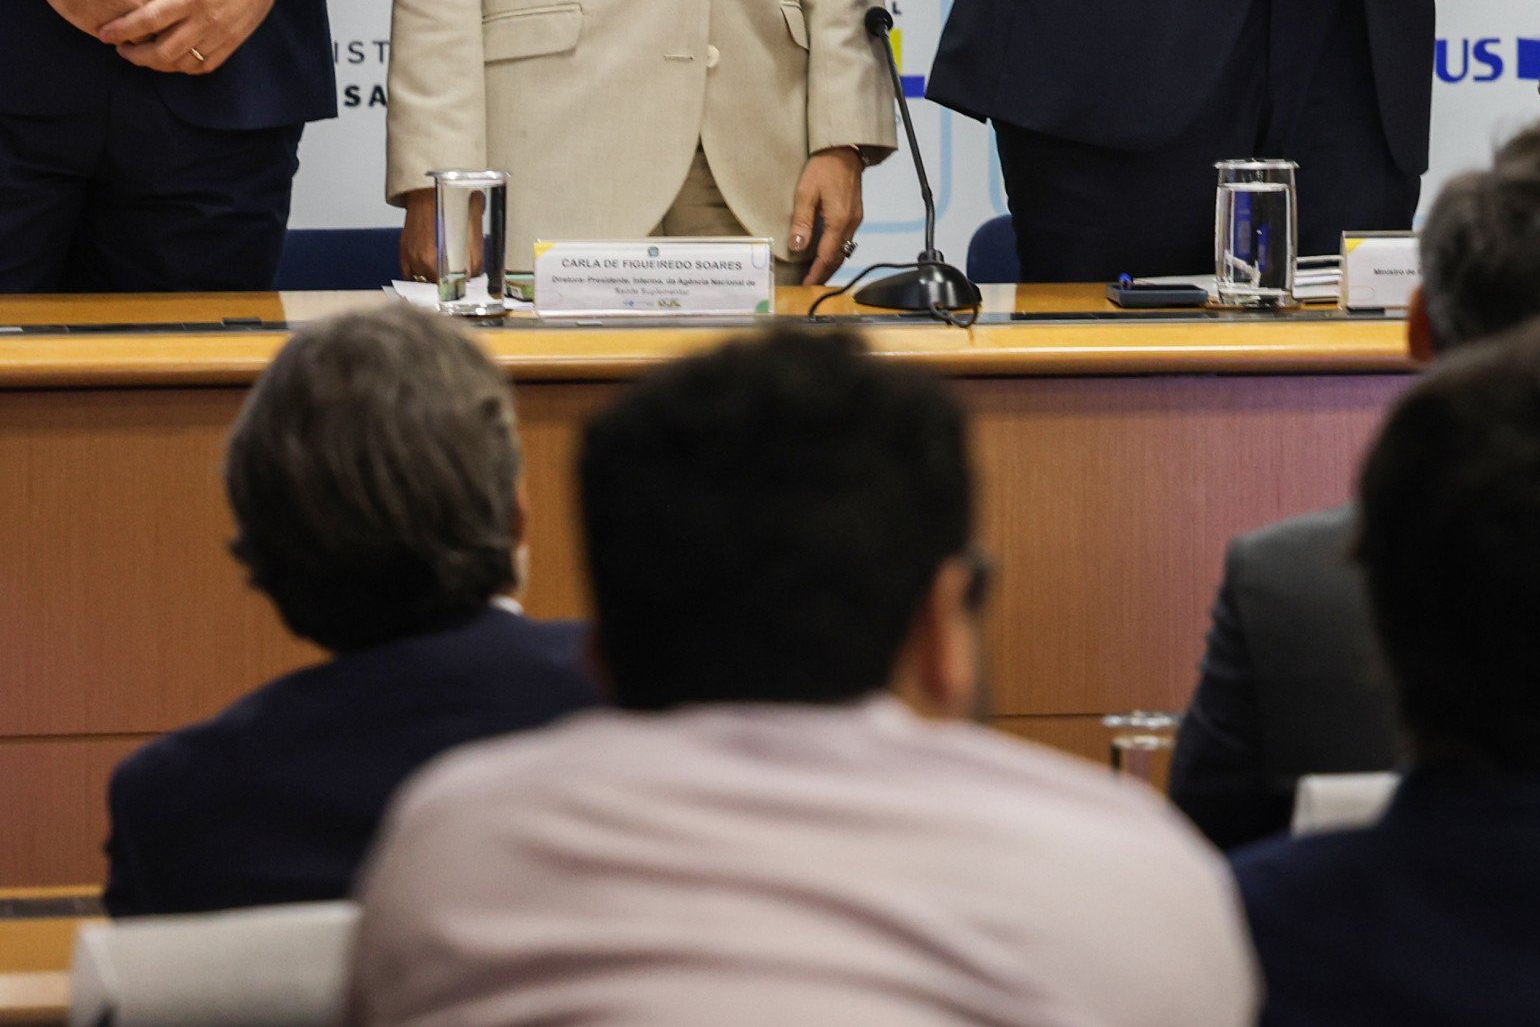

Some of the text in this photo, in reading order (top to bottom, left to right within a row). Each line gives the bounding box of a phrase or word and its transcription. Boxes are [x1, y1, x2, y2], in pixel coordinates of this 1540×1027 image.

[1435, 38, 1504, 83] US
[561, 258, 743, 271] CARLA DE FIGUEIREDO SOARES
